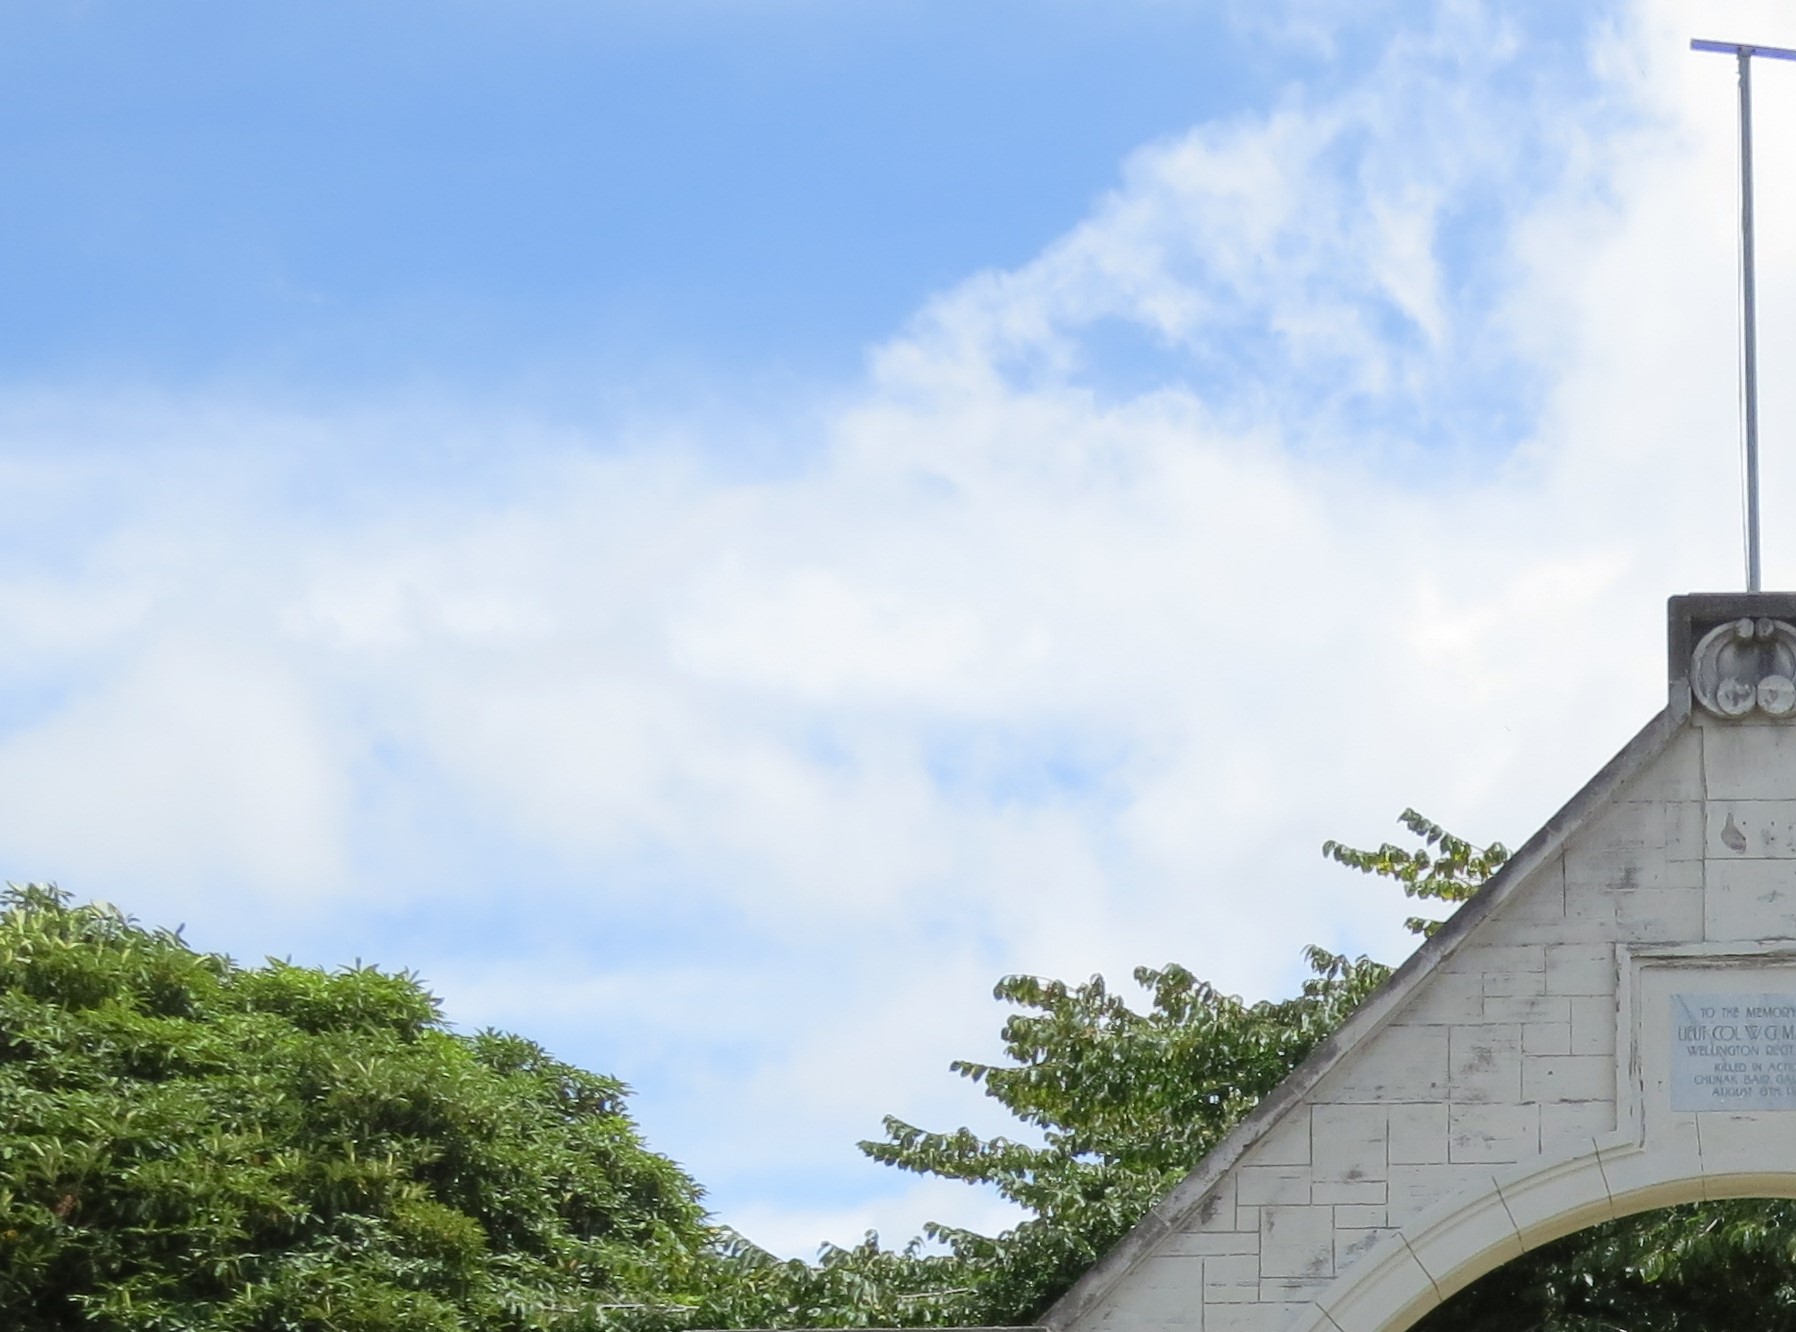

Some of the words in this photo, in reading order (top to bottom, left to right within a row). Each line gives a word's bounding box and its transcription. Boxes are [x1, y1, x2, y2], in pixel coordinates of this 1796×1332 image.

[1701, 1007, 1715, 1018] TO
[1722, 1007, 1739, 1018] THE
[1746, 1007, 1796, 1018] MEMORY
[1687, 1045, 1759, 1056] WELLINGTON
[1714, 1062, 1747, 1072] KILLED
[1752, 1062, 1762, 1072] IN
[1712, 1087, 1752, 1097] AUGUST
